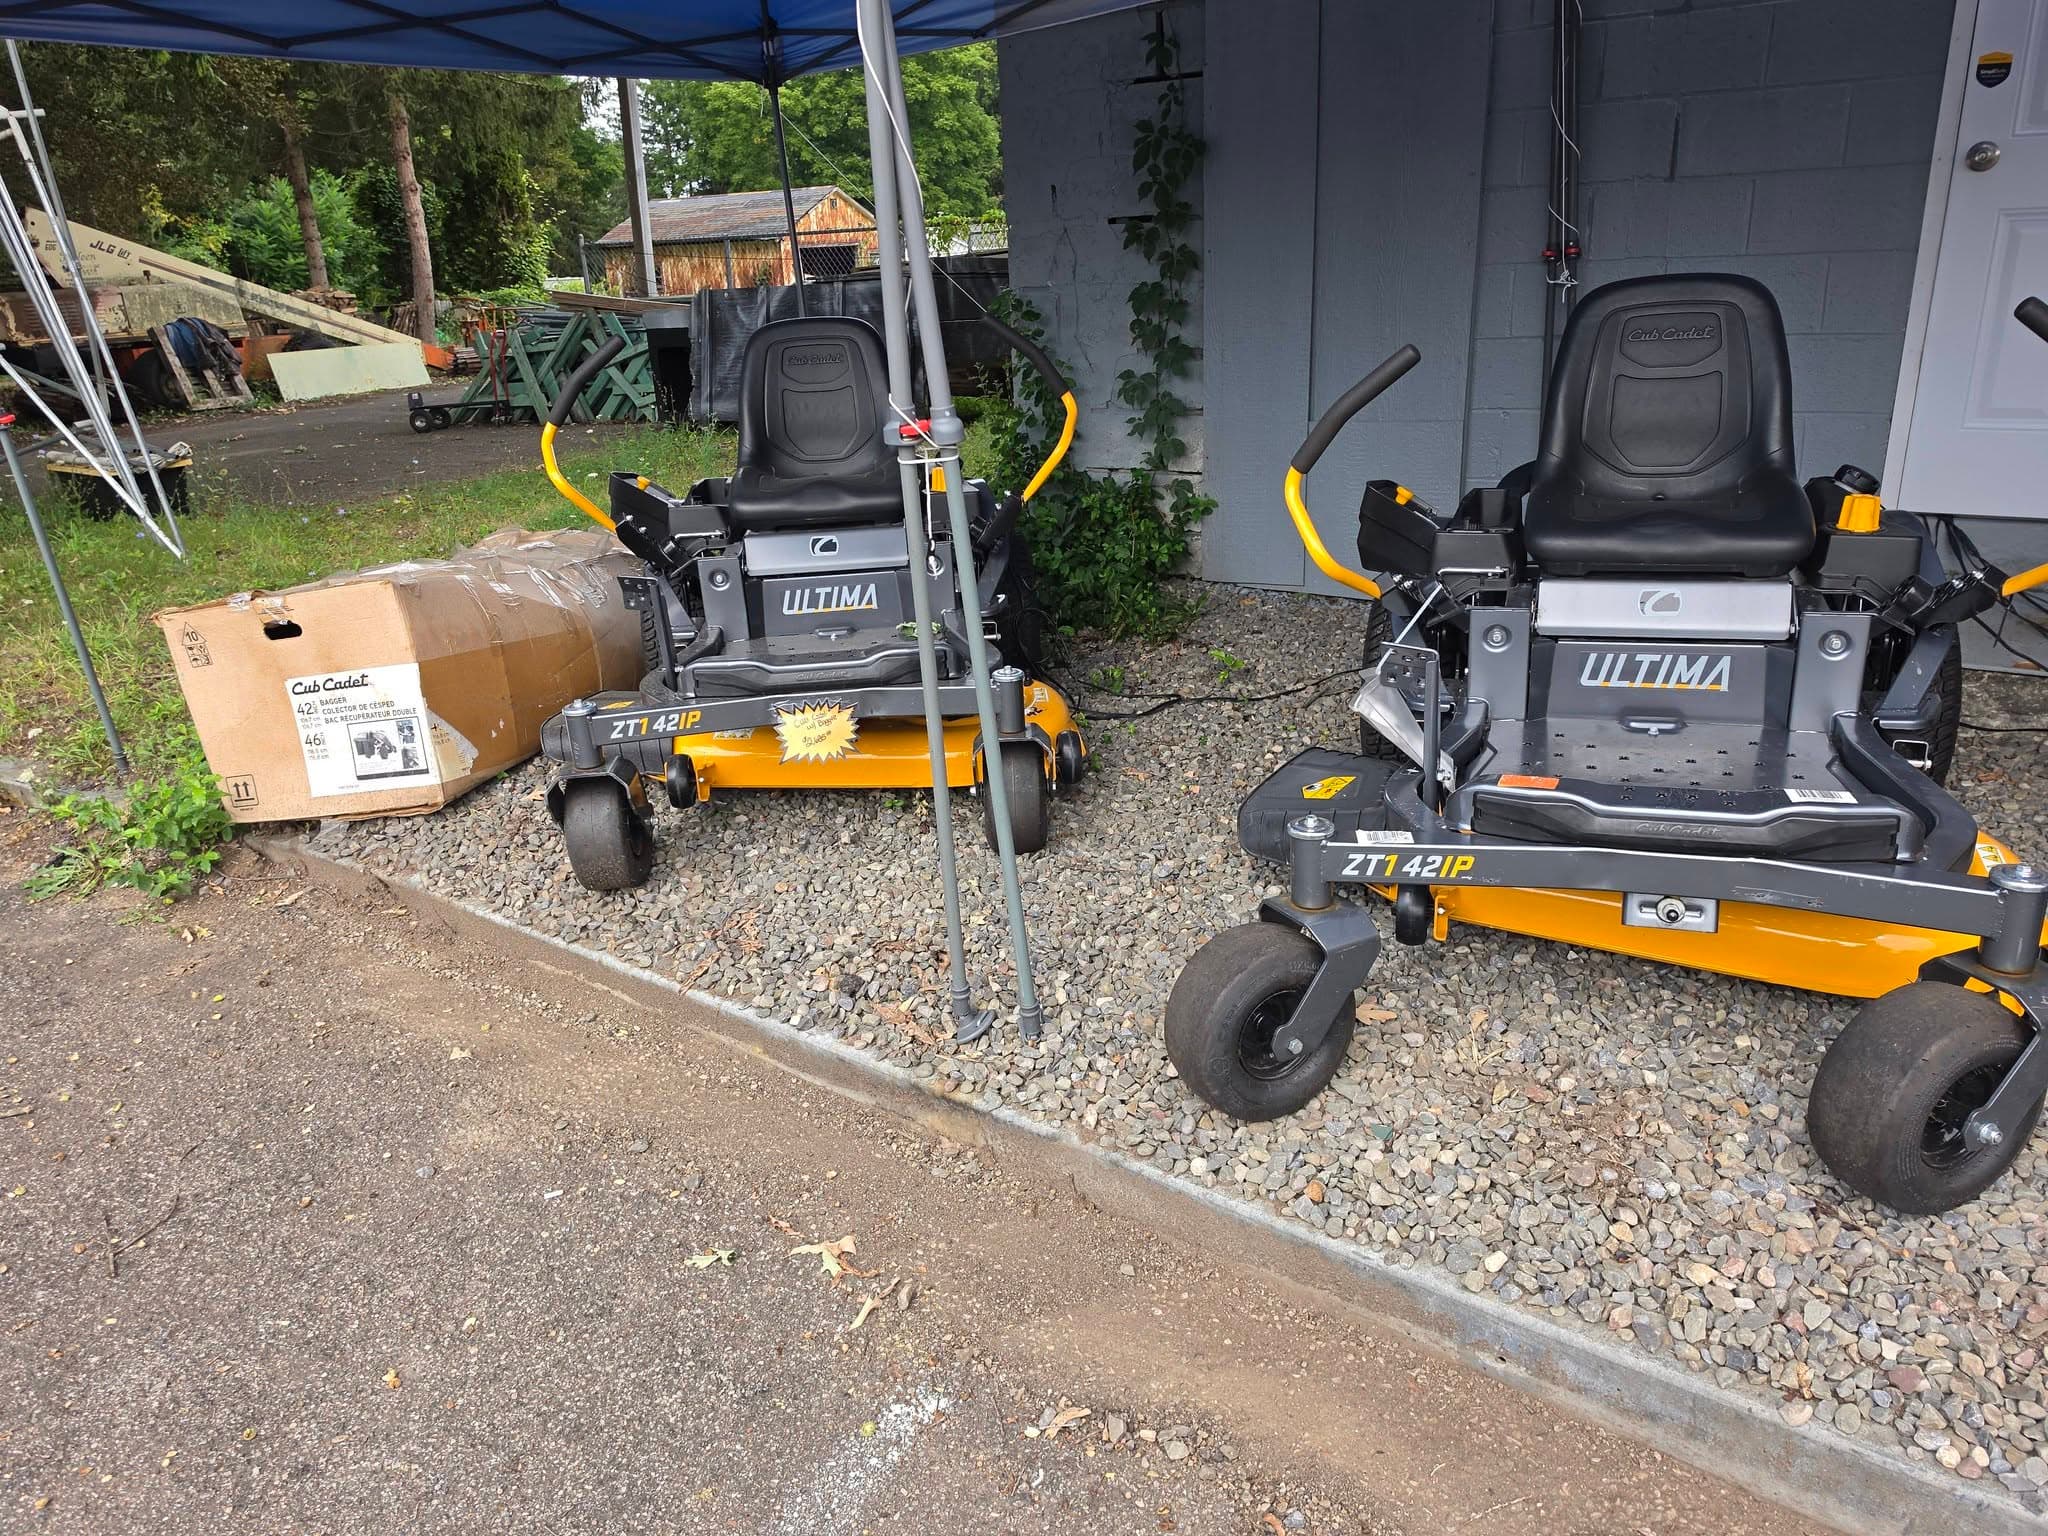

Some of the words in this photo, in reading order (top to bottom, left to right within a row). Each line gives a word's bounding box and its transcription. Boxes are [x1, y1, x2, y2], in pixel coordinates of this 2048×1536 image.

[89, 240, 116, 254] JLG
[1628, 329, 1659, 341] Cub
[1662, 326, 1714, 340] Cadet
[783, 583, 878, 615] ULTIMA
[185, 631, 199, 642] 10
[1580, 653, 1731, 692] ULTIMA
[292, 680, 320, 695] Cub
[322, 674, 368, 691] Cadet
[319, 696, 347, 706] BAGGER
[297, 702, 314, 716] 42
[322, 705, 357, 715] COLECTOR
[358, 703, 368, 711] DE
[324, 716, 339, 725] BAC
[393, 707, 417, 717] DOUBLE
[610, 717, 649, 740] ZT1
[652, 710, 702, 733] 42IP
[305, 733, 322, 747] 46
[1341, 853, 1399, 877] ZT1
[1402, 855, 1476, 878] 42IP
